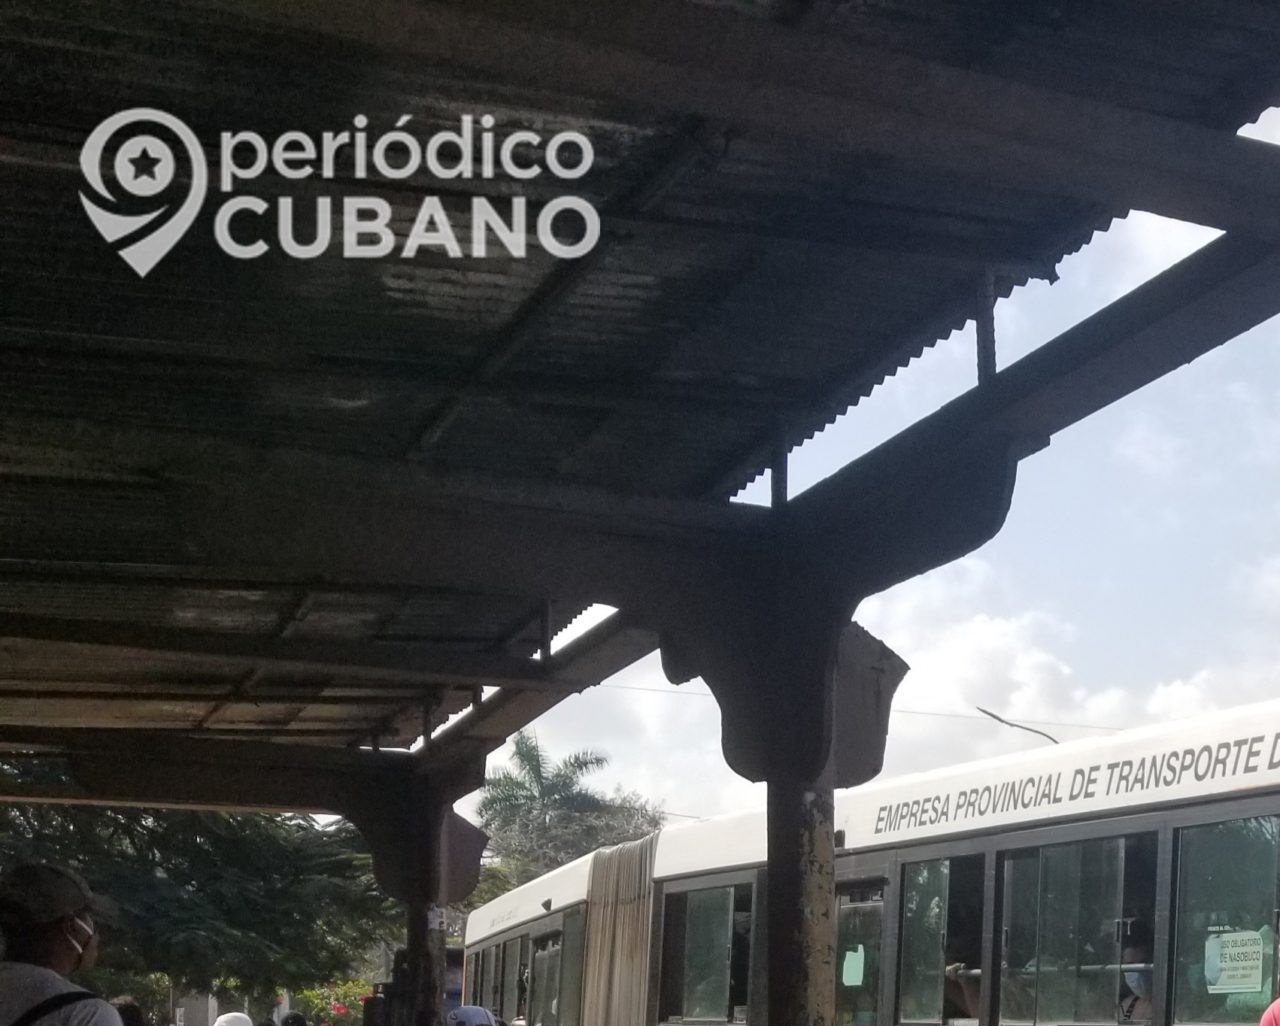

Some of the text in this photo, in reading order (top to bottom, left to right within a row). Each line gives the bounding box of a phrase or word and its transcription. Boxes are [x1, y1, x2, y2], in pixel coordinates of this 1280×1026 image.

[874, 794, 950, 834] EMPRESA
[953, 772, 1062, 820] PROVINCIAL
[1069, 765, 1101, 801] DE
[1106, 735, 1265, 796] TRANSPORTE
